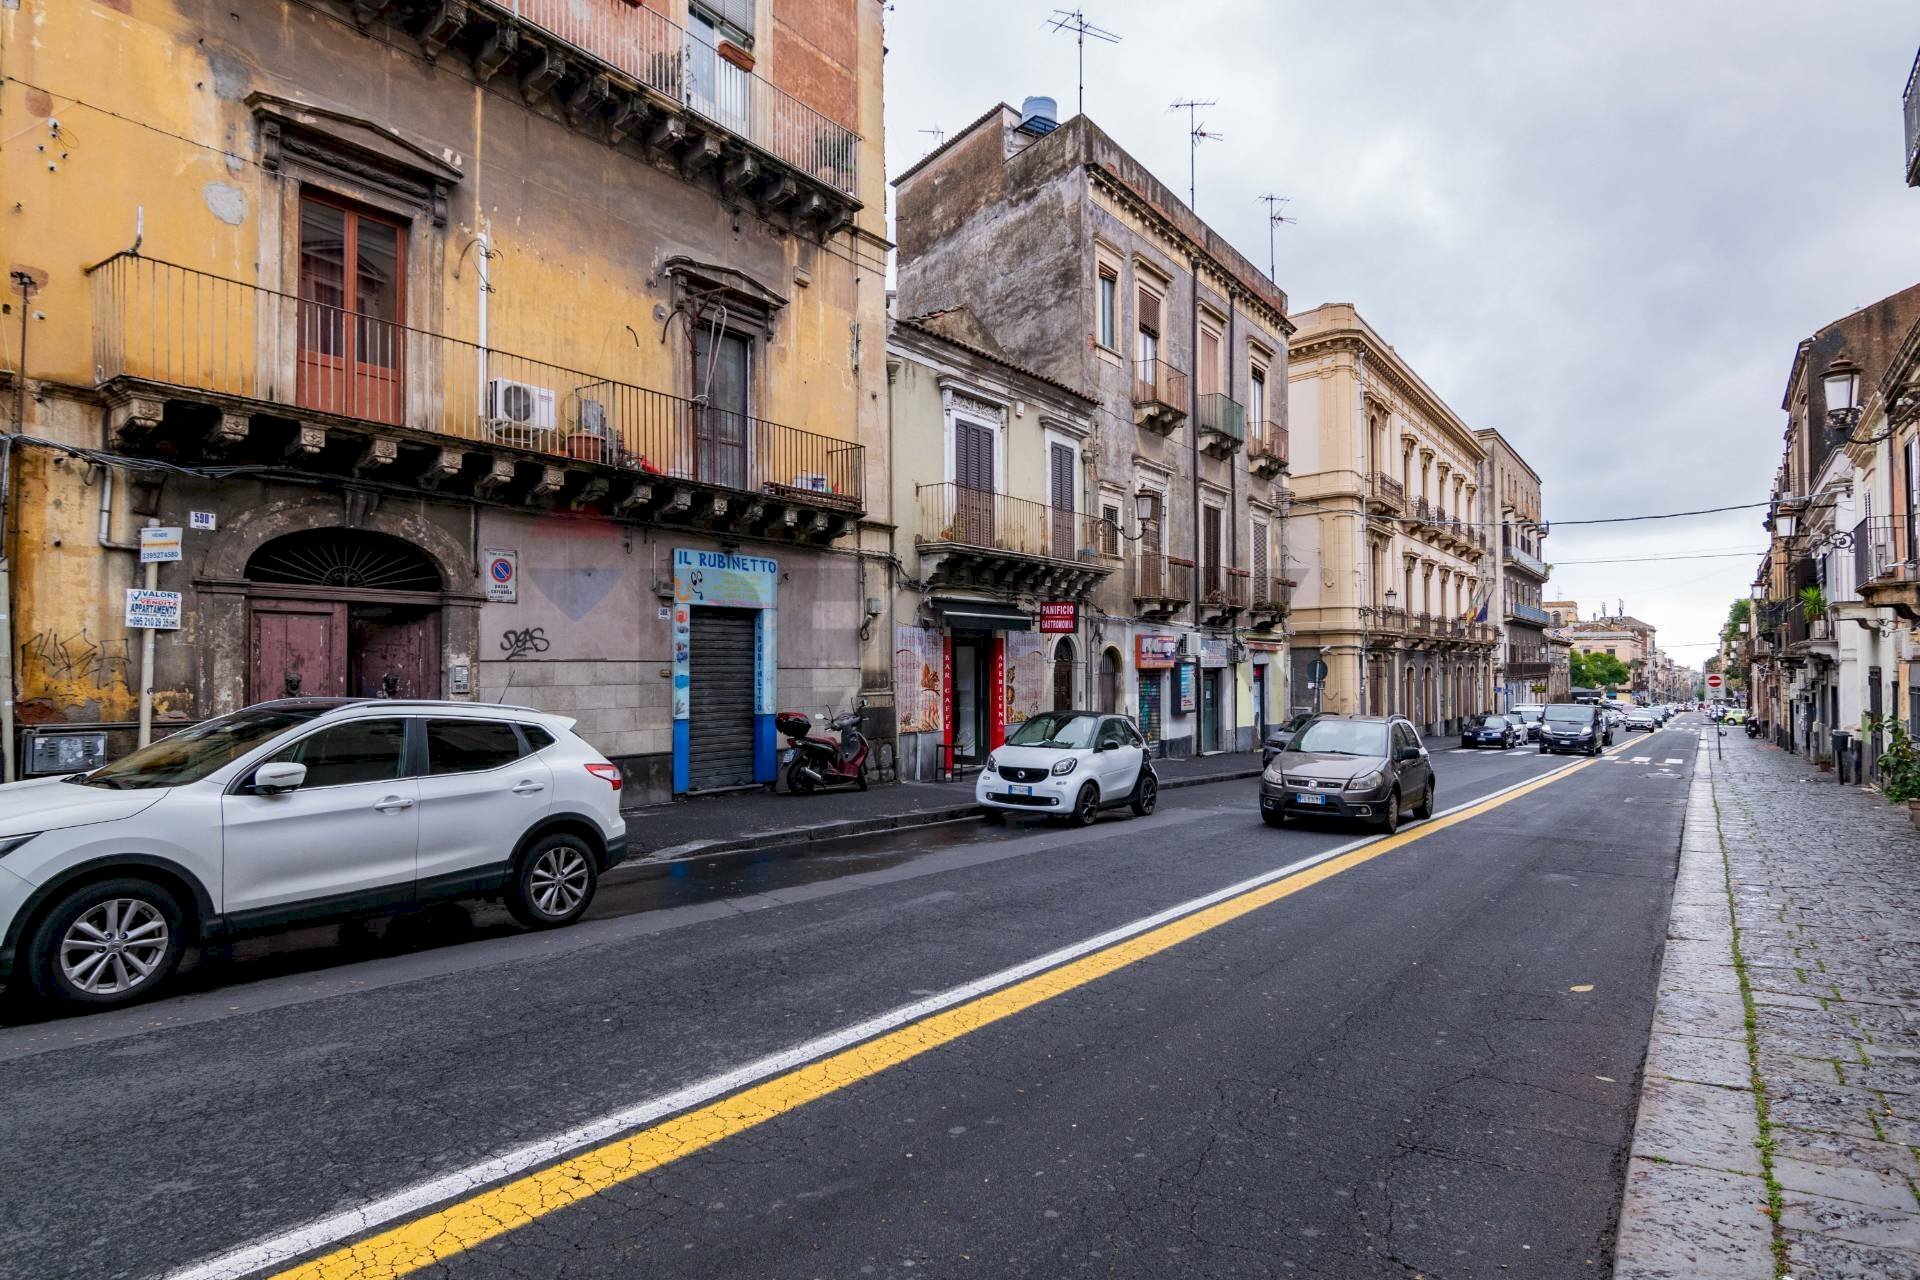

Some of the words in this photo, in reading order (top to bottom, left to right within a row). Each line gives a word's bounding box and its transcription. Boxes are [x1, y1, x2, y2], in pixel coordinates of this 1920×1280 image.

[195, 512, 209, 524] 590
[678, 551, 692, 566] IL
[699, 552, 777, 574] RUBINETTO
[143, 591, 178, 599] VALORE
[130, 603, 177, 615] APPARTAMENTO
[1042, 605, 1074, 615] PANIFICIO
[1042, 620, 1074, 629] GASTRONOMIA
